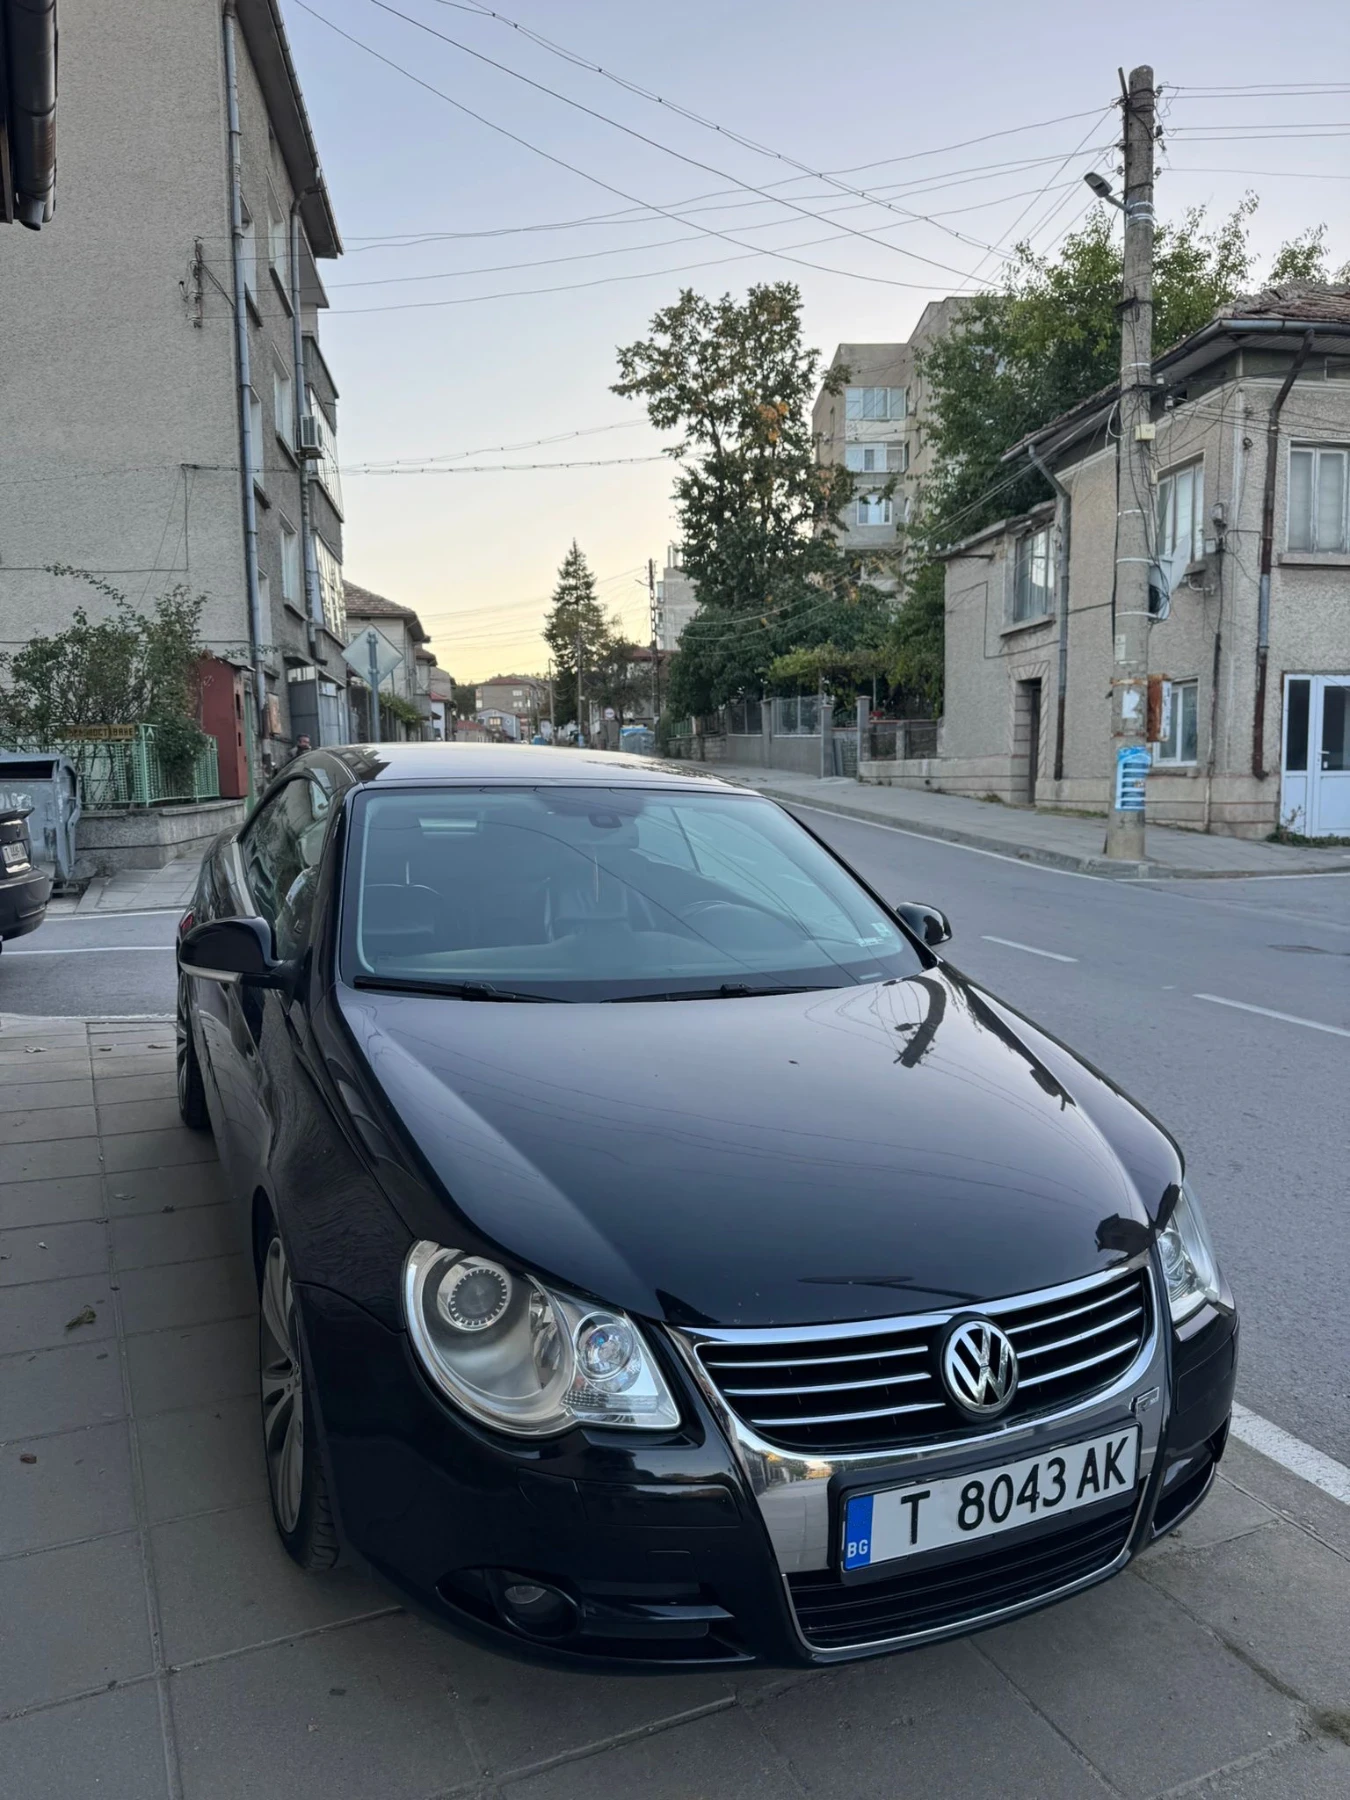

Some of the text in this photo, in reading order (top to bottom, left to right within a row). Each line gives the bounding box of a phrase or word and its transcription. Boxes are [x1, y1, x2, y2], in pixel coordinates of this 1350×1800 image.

[900, 1435, 1129, 1546] T 8043 AK
[847, 1539, 868, 1558] BG
